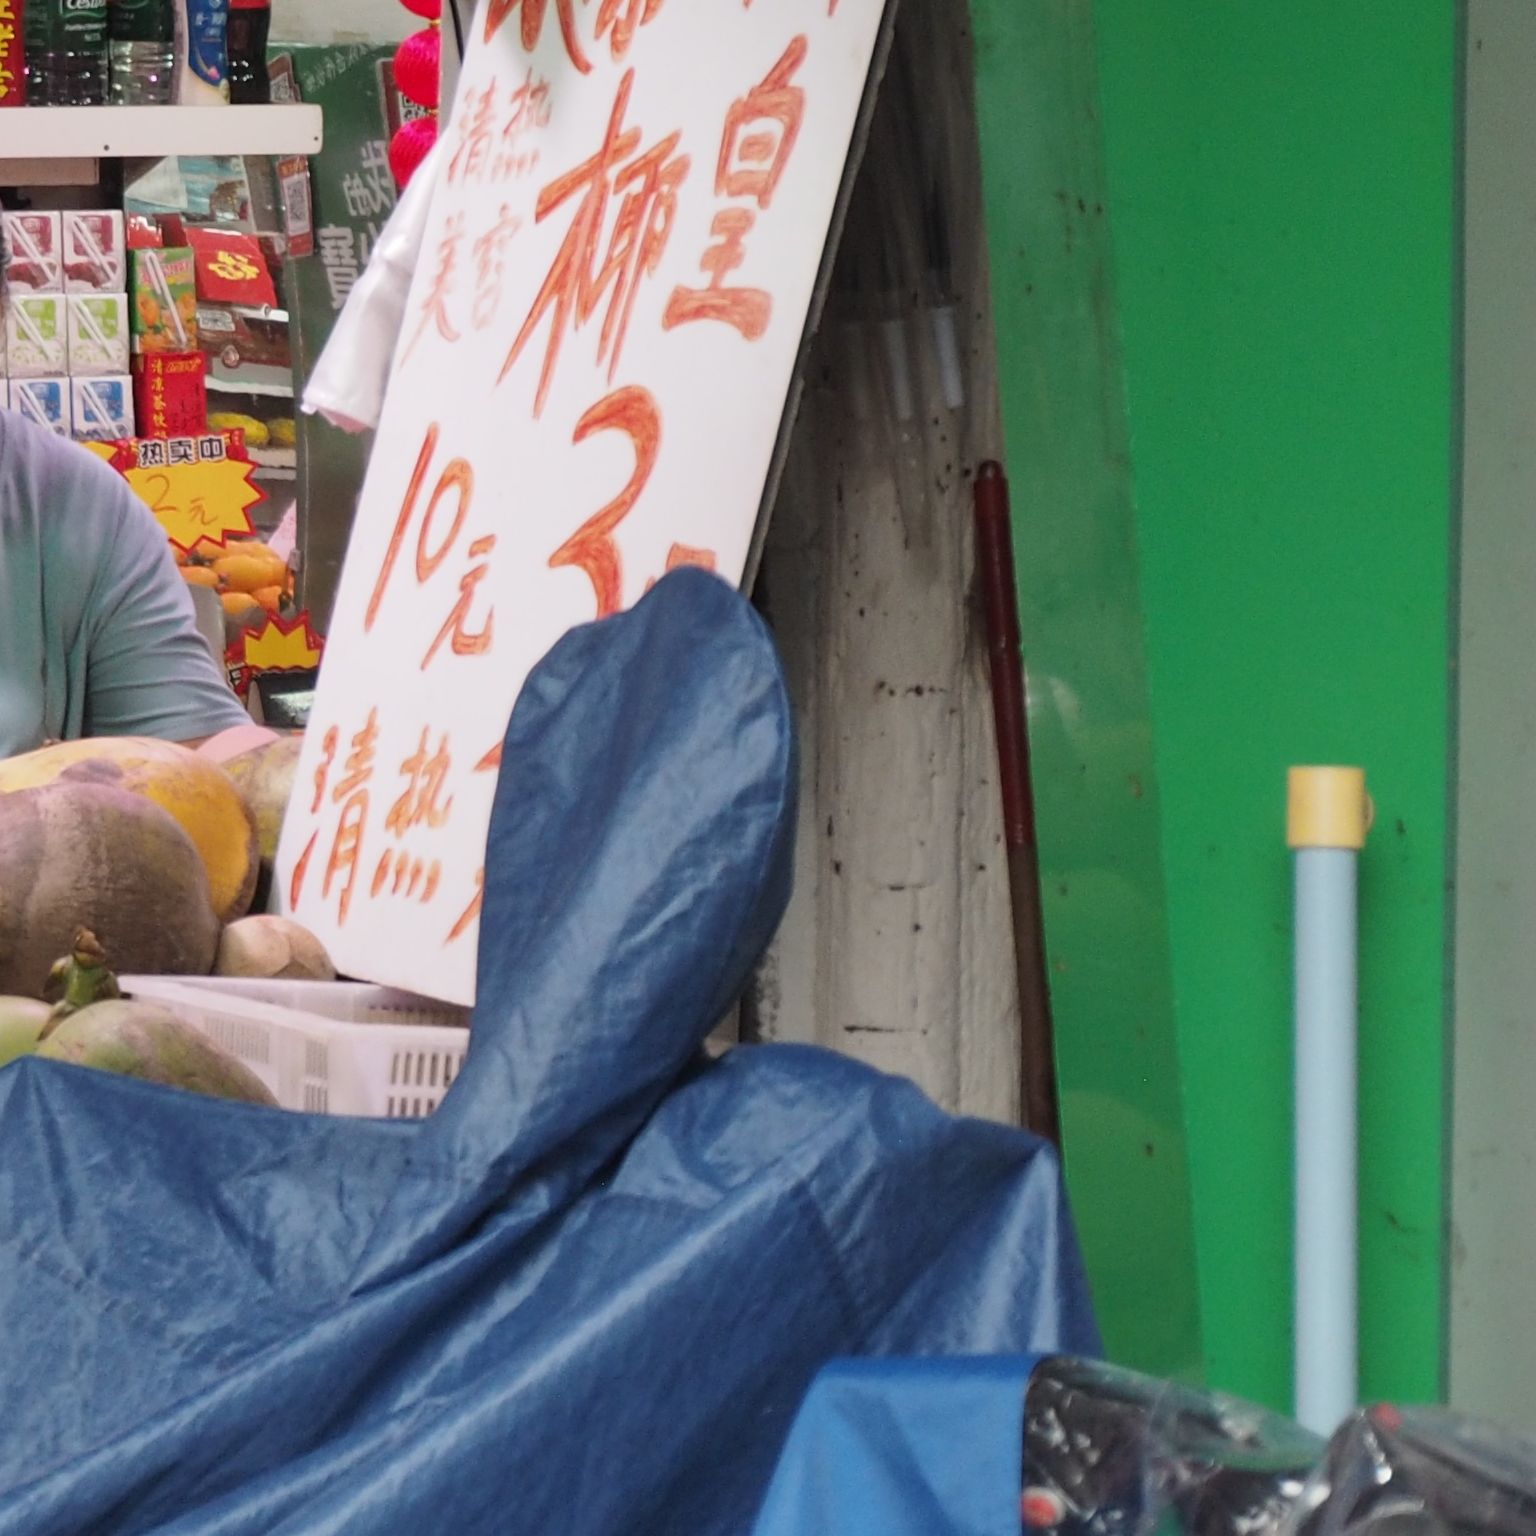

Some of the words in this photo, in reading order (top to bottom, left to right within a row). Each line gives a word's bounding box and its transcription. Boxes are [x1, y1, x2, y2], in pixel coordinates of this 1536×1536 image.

[140, 437, 226, 466] 热卖中
[145, 473, 220, 526] 2元
